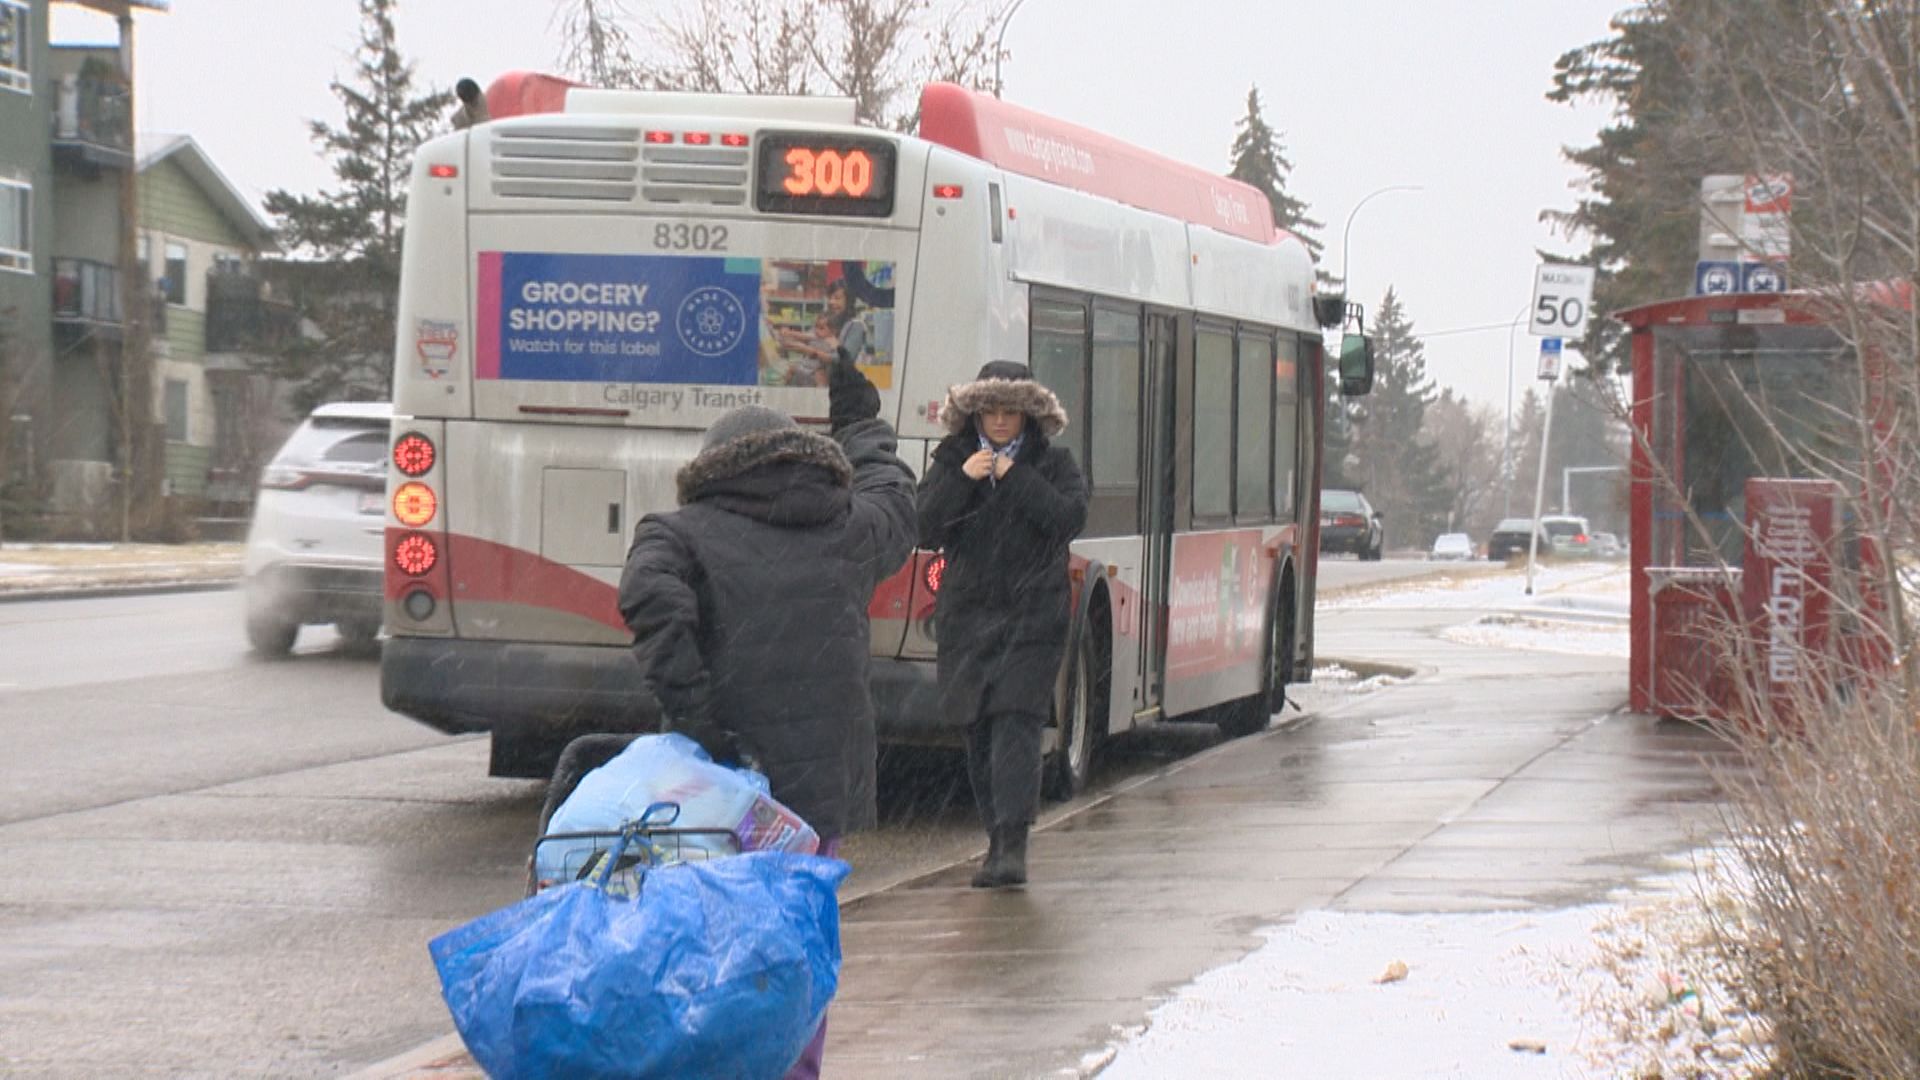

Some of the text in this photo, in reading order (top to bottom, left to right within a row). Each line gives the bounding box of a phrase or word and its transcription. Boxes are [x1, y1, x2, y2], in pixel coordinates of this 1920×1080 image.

[784, 147, 872, 196] 300
[653, 223, 729, 250] 8302
[1541, 272, 1585, 284] MAXIM
[522, 281, 649, 305] GROCERY
[687, 292, 718, 313] MADE
[509, 307, 661, 333] SHOPPING?
[1536, 295, 1583, 328] 50
[509, 338, 661, 356] Watch for this label
[684, 330, 737, 350] ALBERTA
[603, 384, 762, 412] Calgary Transit
